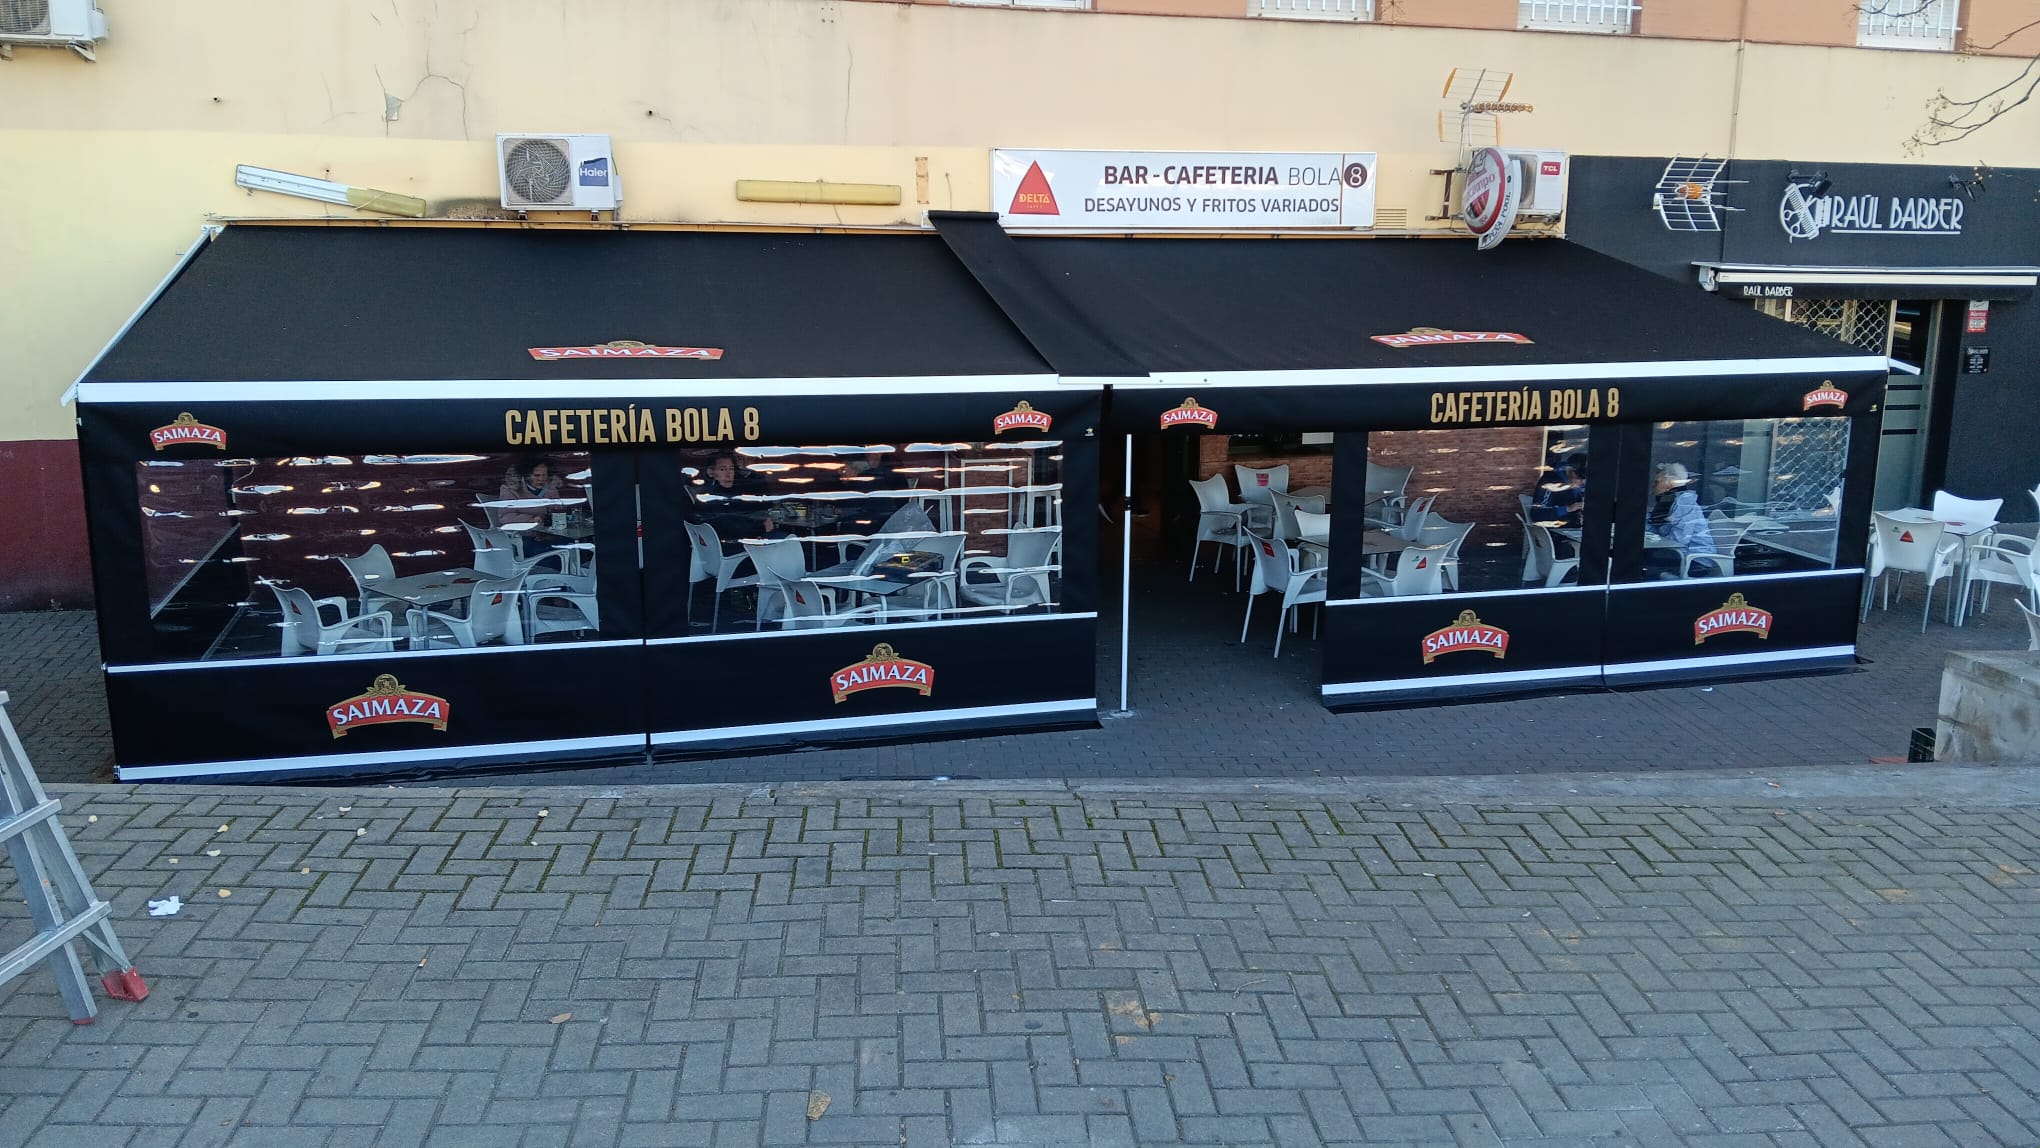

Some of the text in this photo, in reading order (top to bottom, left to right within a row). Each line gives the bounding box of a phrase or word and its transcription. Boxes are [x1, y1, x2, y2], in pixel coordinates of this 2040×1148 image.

[579, 167, 608, 177] Haier
[1288, 167, 1342, 186] BOLA
[1019, 193, 1051, 204] DELTA
[1084, 197, 1340, 213] DESAYUNOS Y FRITOS VARIADOS
[1831, 194, 1964, 230] RAÚL BARBER
[1379, 332, 1517, 345] SAIMAZA
[537, 348, 711, 357] SAIMAZA
[1430, 385, 1620, 424] CAFETERÍA BOLA 8
[1806, 391, 1846, 404] SAIMAZA
[505, 403, 760, 446] CAFETERÍA BOLA 8
[996, 413, 1049, 428] SAIMAZA
[1163, 410, 1214, 424] SAIMAZA
[153, 427, 222, 443] SAIMAZA
[1697, 612, 1768, 634] SAIMAZA
[1426, 629, 1504, 653] SAIMAZA
[836, 664, 928, 691] SAIMAZA
[332, 698, 441, 726] SAIMAZA
